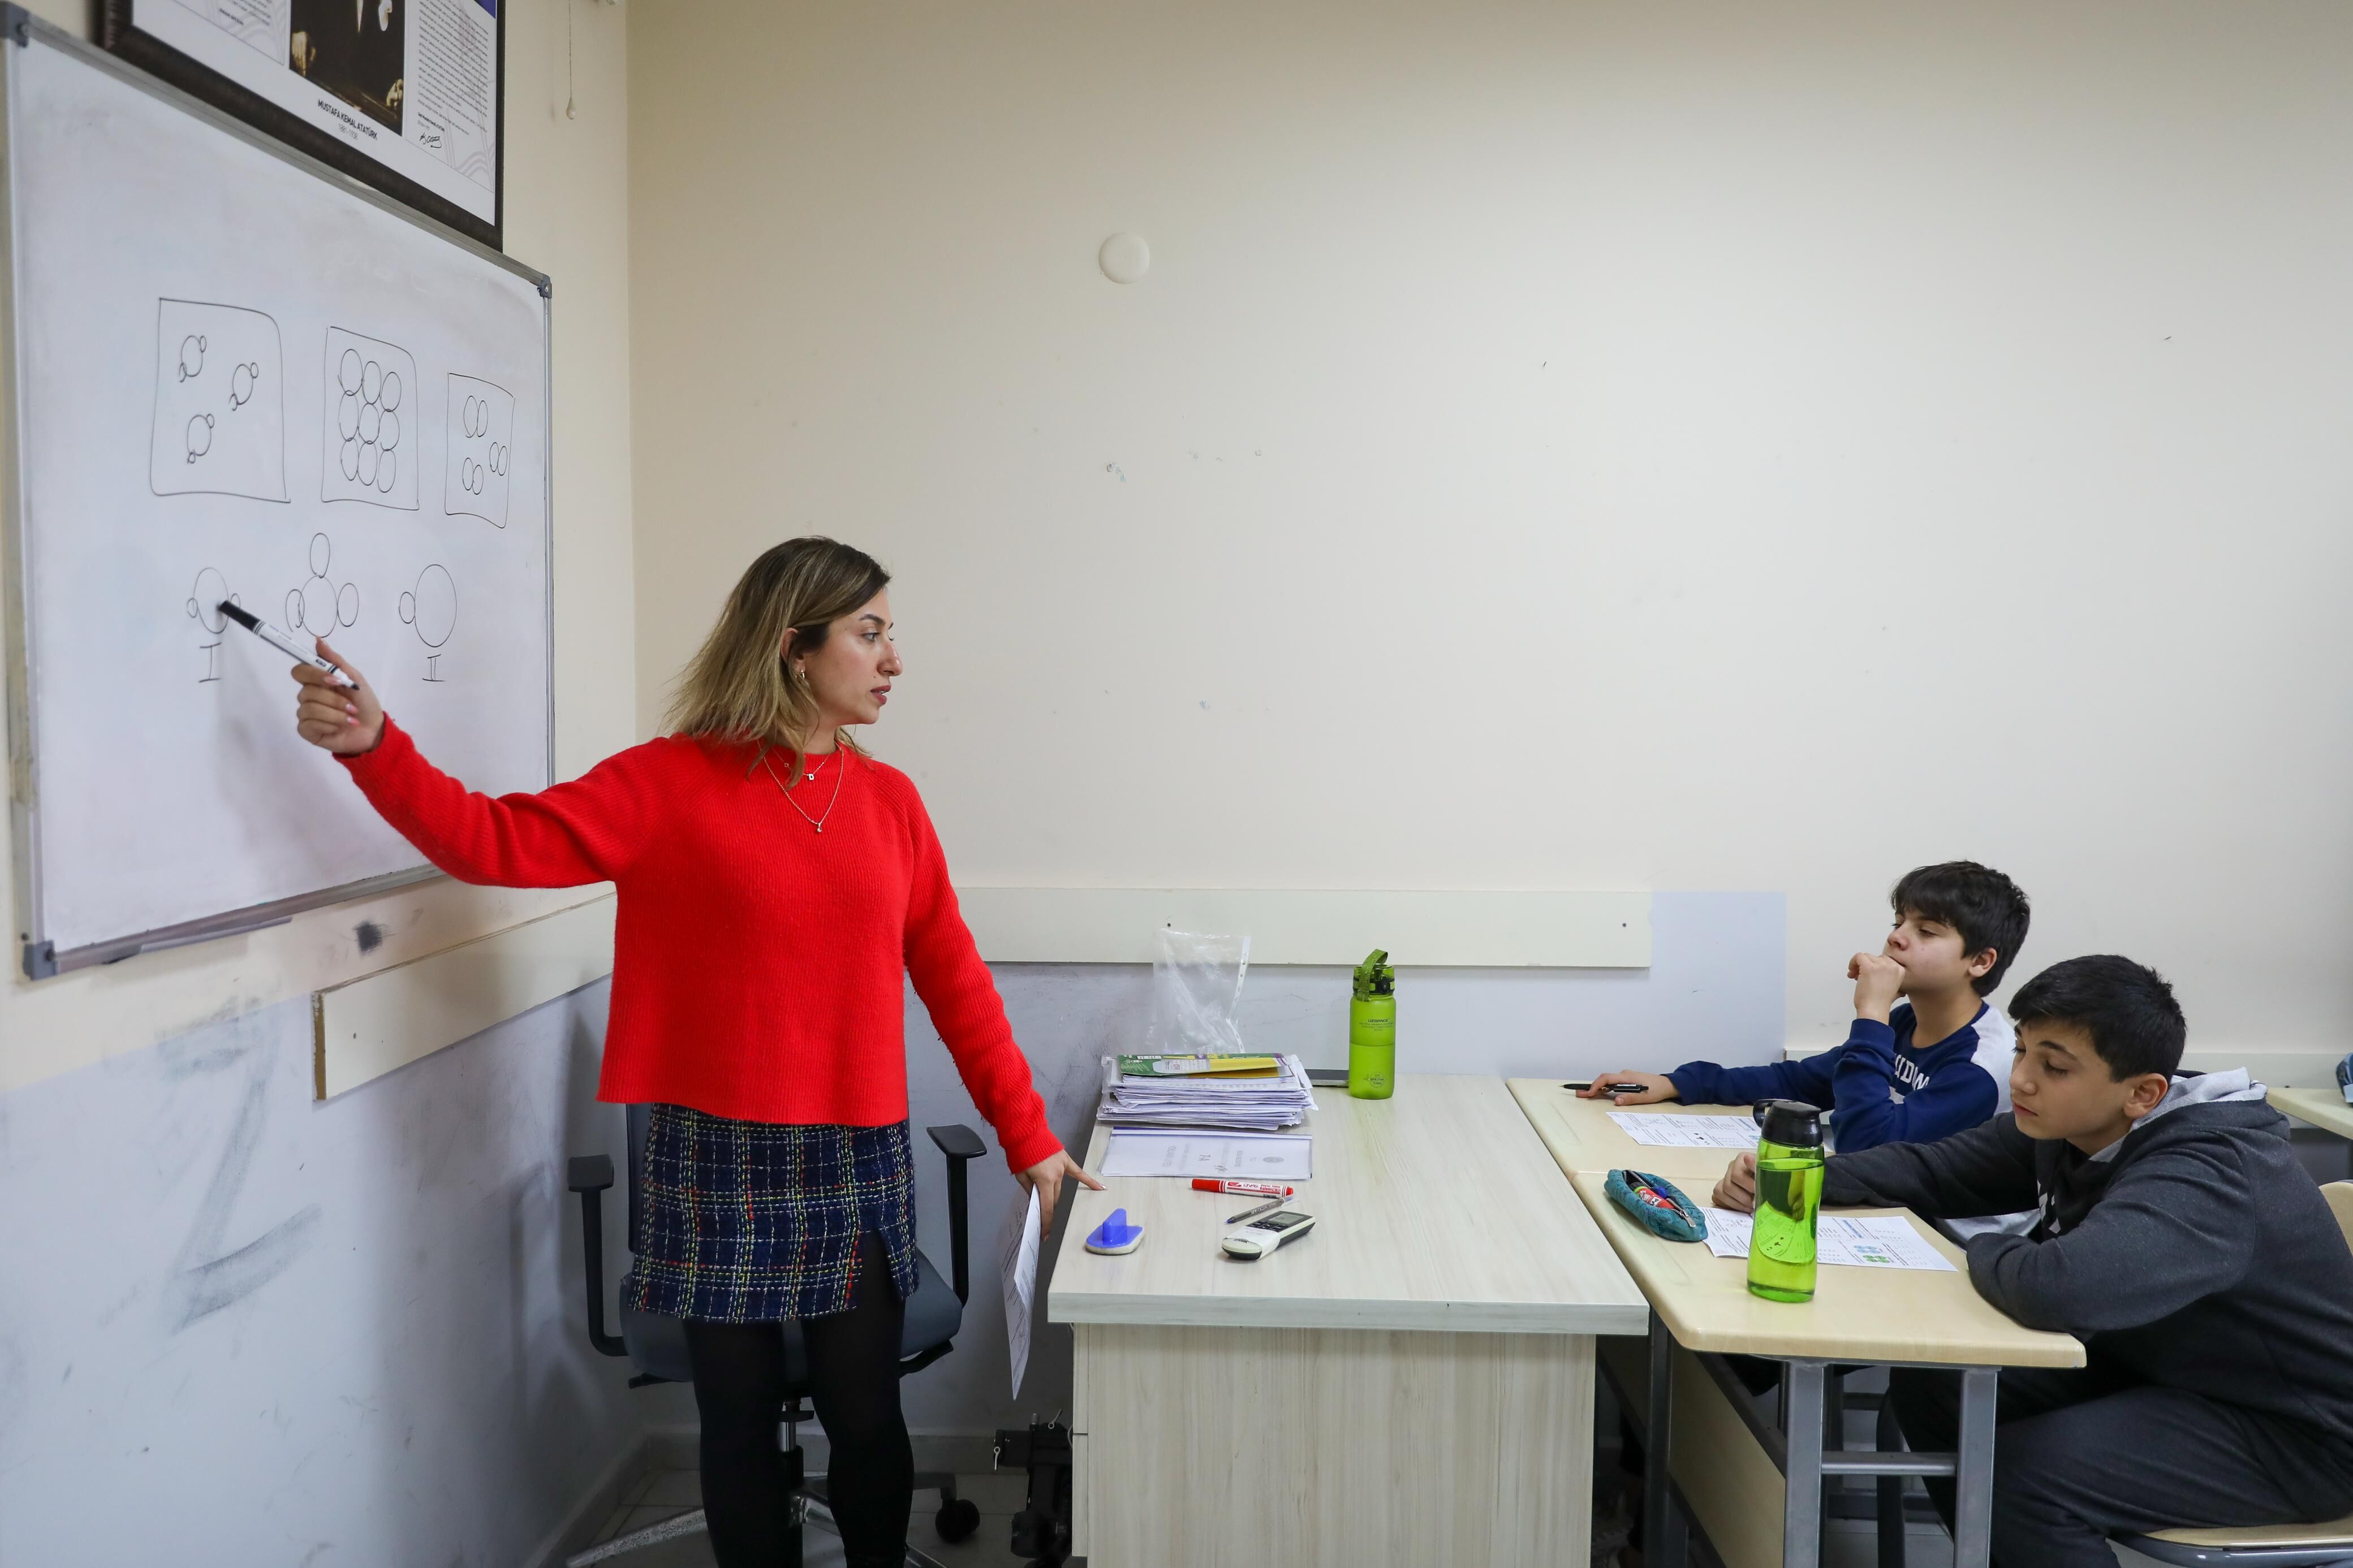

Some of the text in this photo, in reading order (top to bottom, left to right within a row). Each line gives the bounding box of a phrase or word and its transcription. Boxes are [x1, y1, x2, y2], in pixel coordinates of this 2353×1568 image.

[318, 100, 377, 140] MUSTAFA KEMAL ATATÜRK
